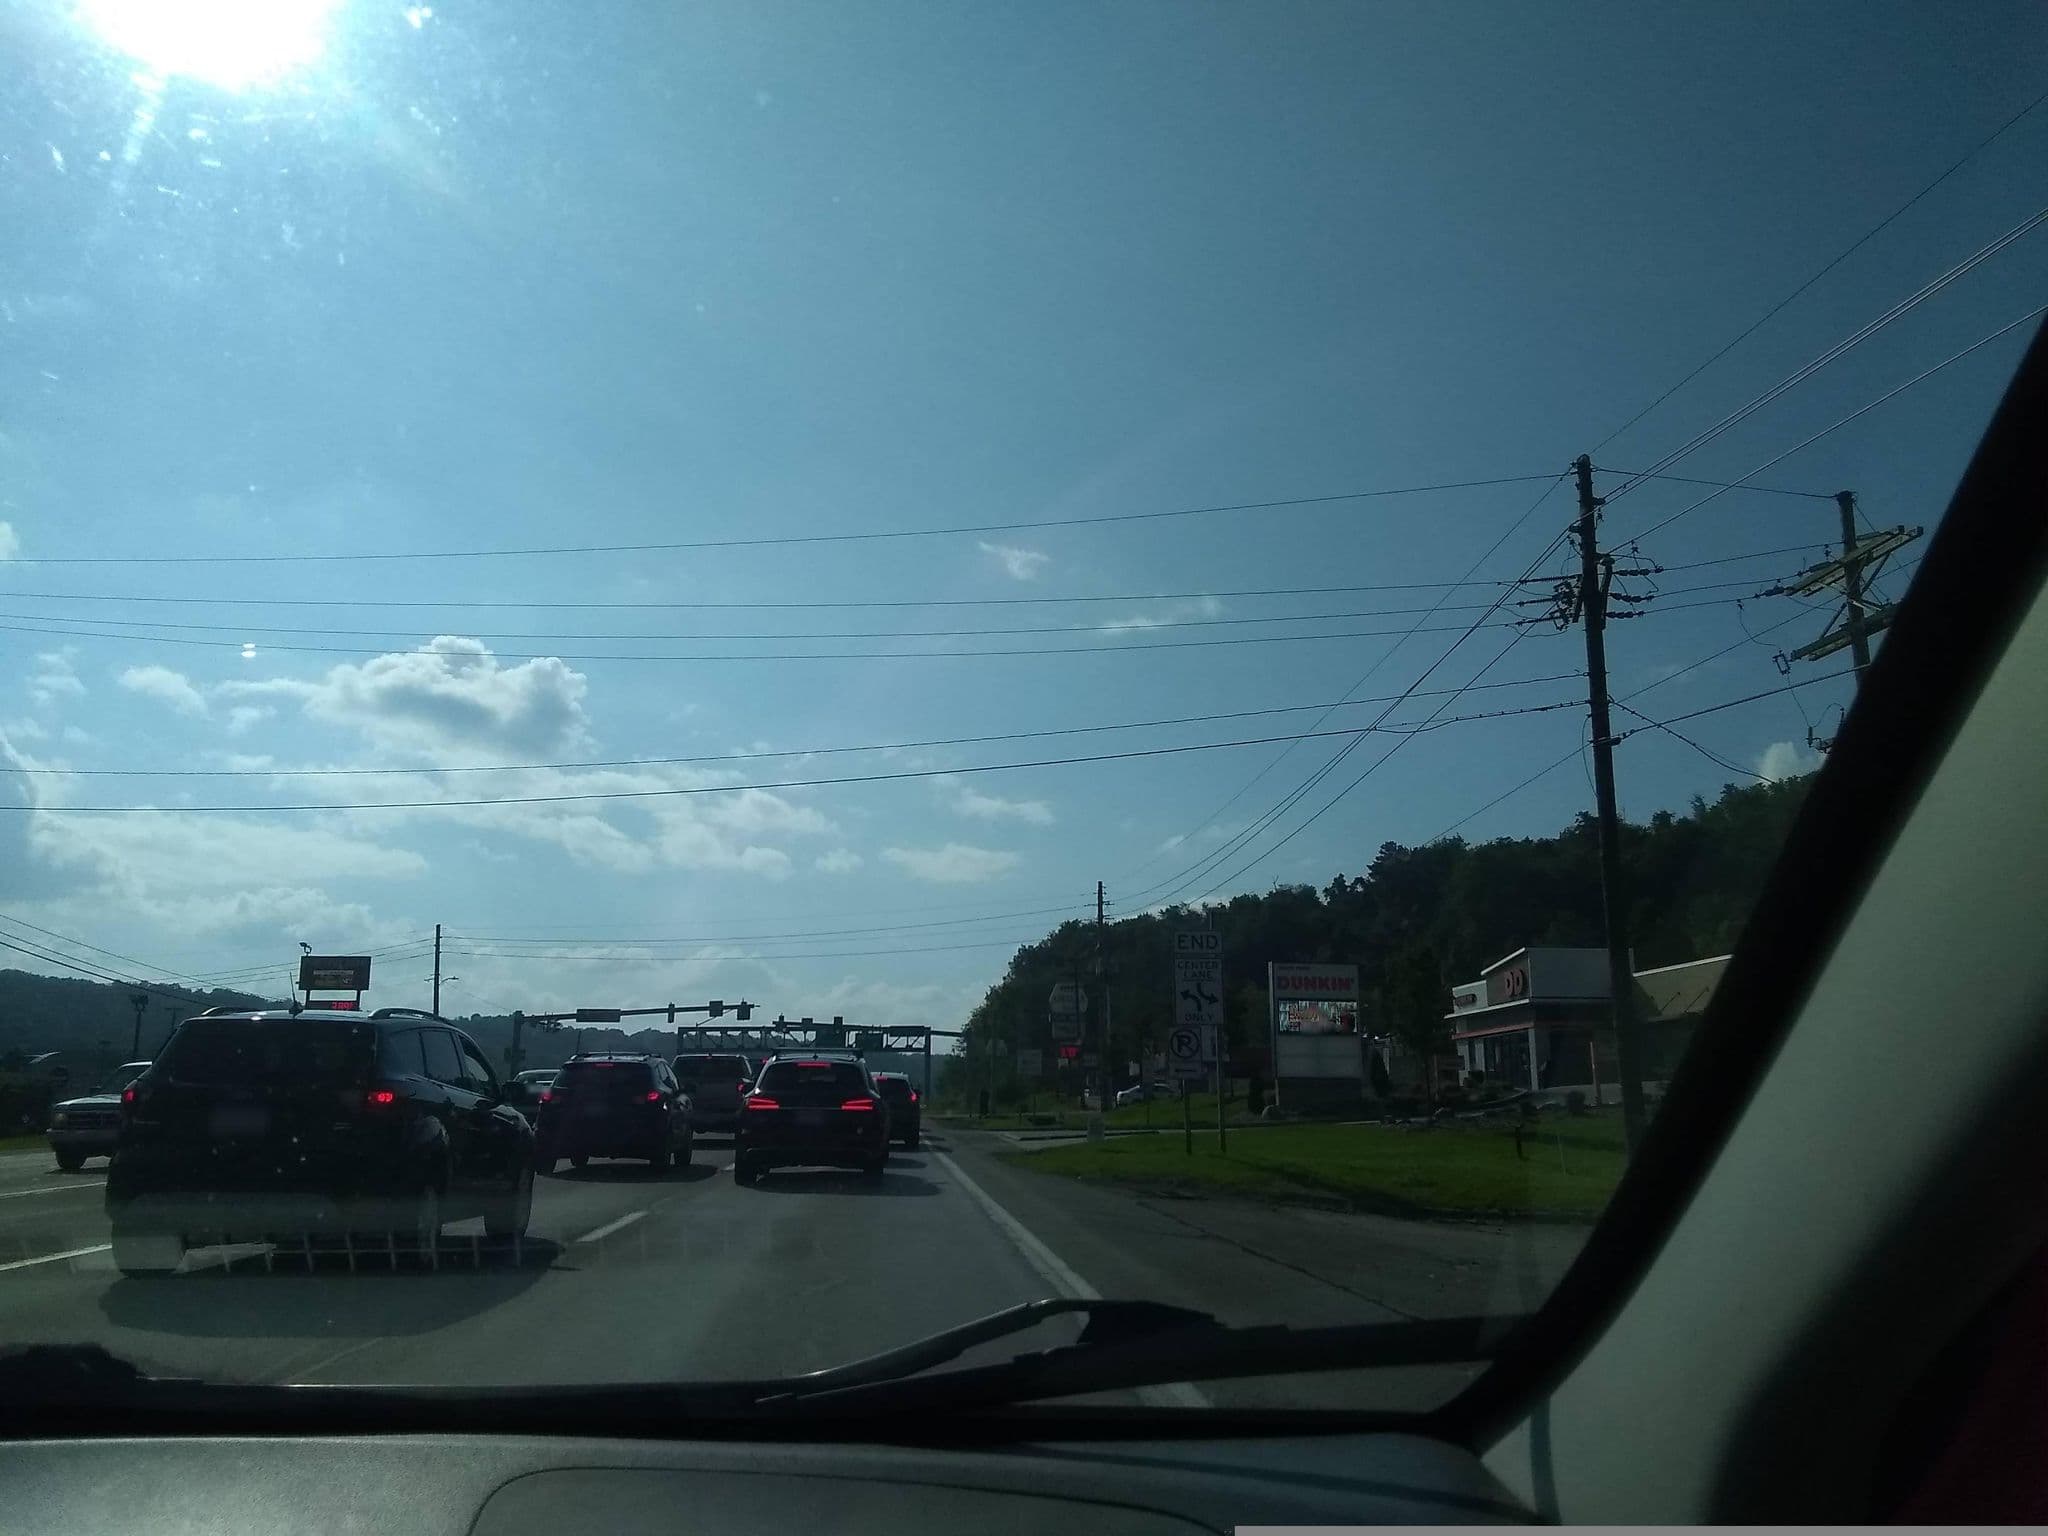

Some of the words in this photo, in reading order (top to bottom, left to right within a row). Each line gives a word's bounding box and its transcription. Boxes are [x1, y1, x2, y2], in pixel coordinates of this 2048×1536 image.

[1178, 934, 1218, 950] END
[1178, 960, 1218, 969] CENTER
[1184, 970, 1213, 979] LANE
[1185, 1013, 1214, 1022] ONLY
